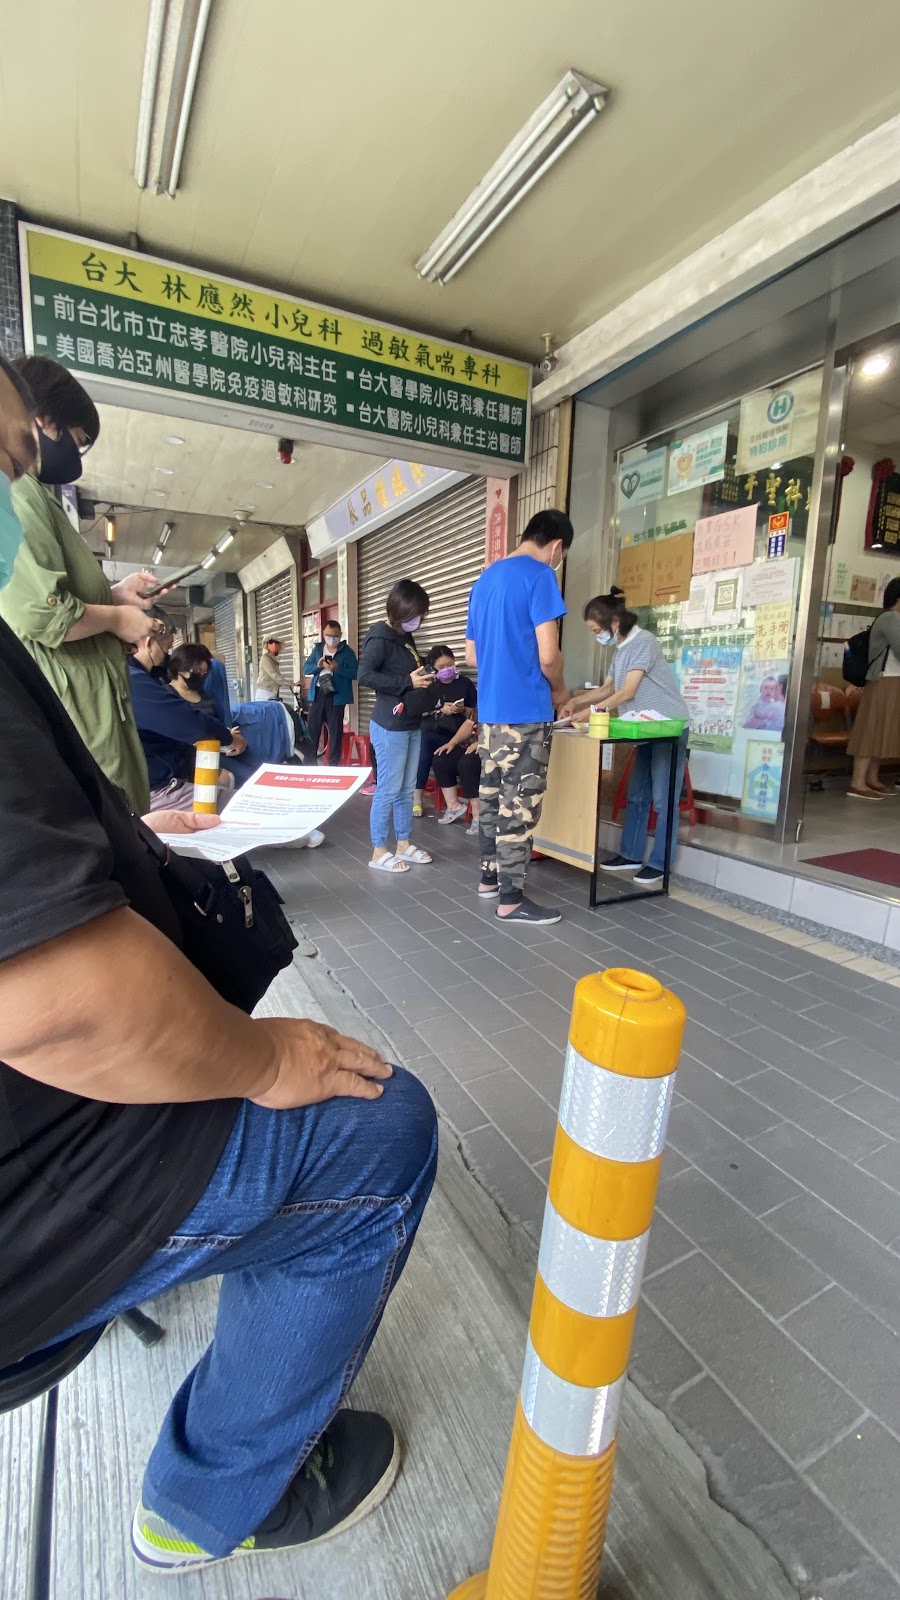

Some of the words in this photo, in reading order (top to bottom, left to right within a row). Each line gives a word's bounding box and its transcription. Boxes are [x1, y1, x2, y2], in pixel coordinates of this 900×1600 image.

[53, 293, 337, 383] 前台北市立忠孝醫院小兒科主任
[82, 252, 142, 293] 台大
[161, 273, 342, 345] 林應然小兒科
[361, 329, 501, 387] 過敏氣喘專科
[56, 333, 337, 416] 美國喬治亞州醫學院免疫過敏科研究
[358, 368, 523, 426] 台大醫學院小兒科兼任講師
[358, 401, 522, 455] 台大醫院小兒科兼任主治醫師
